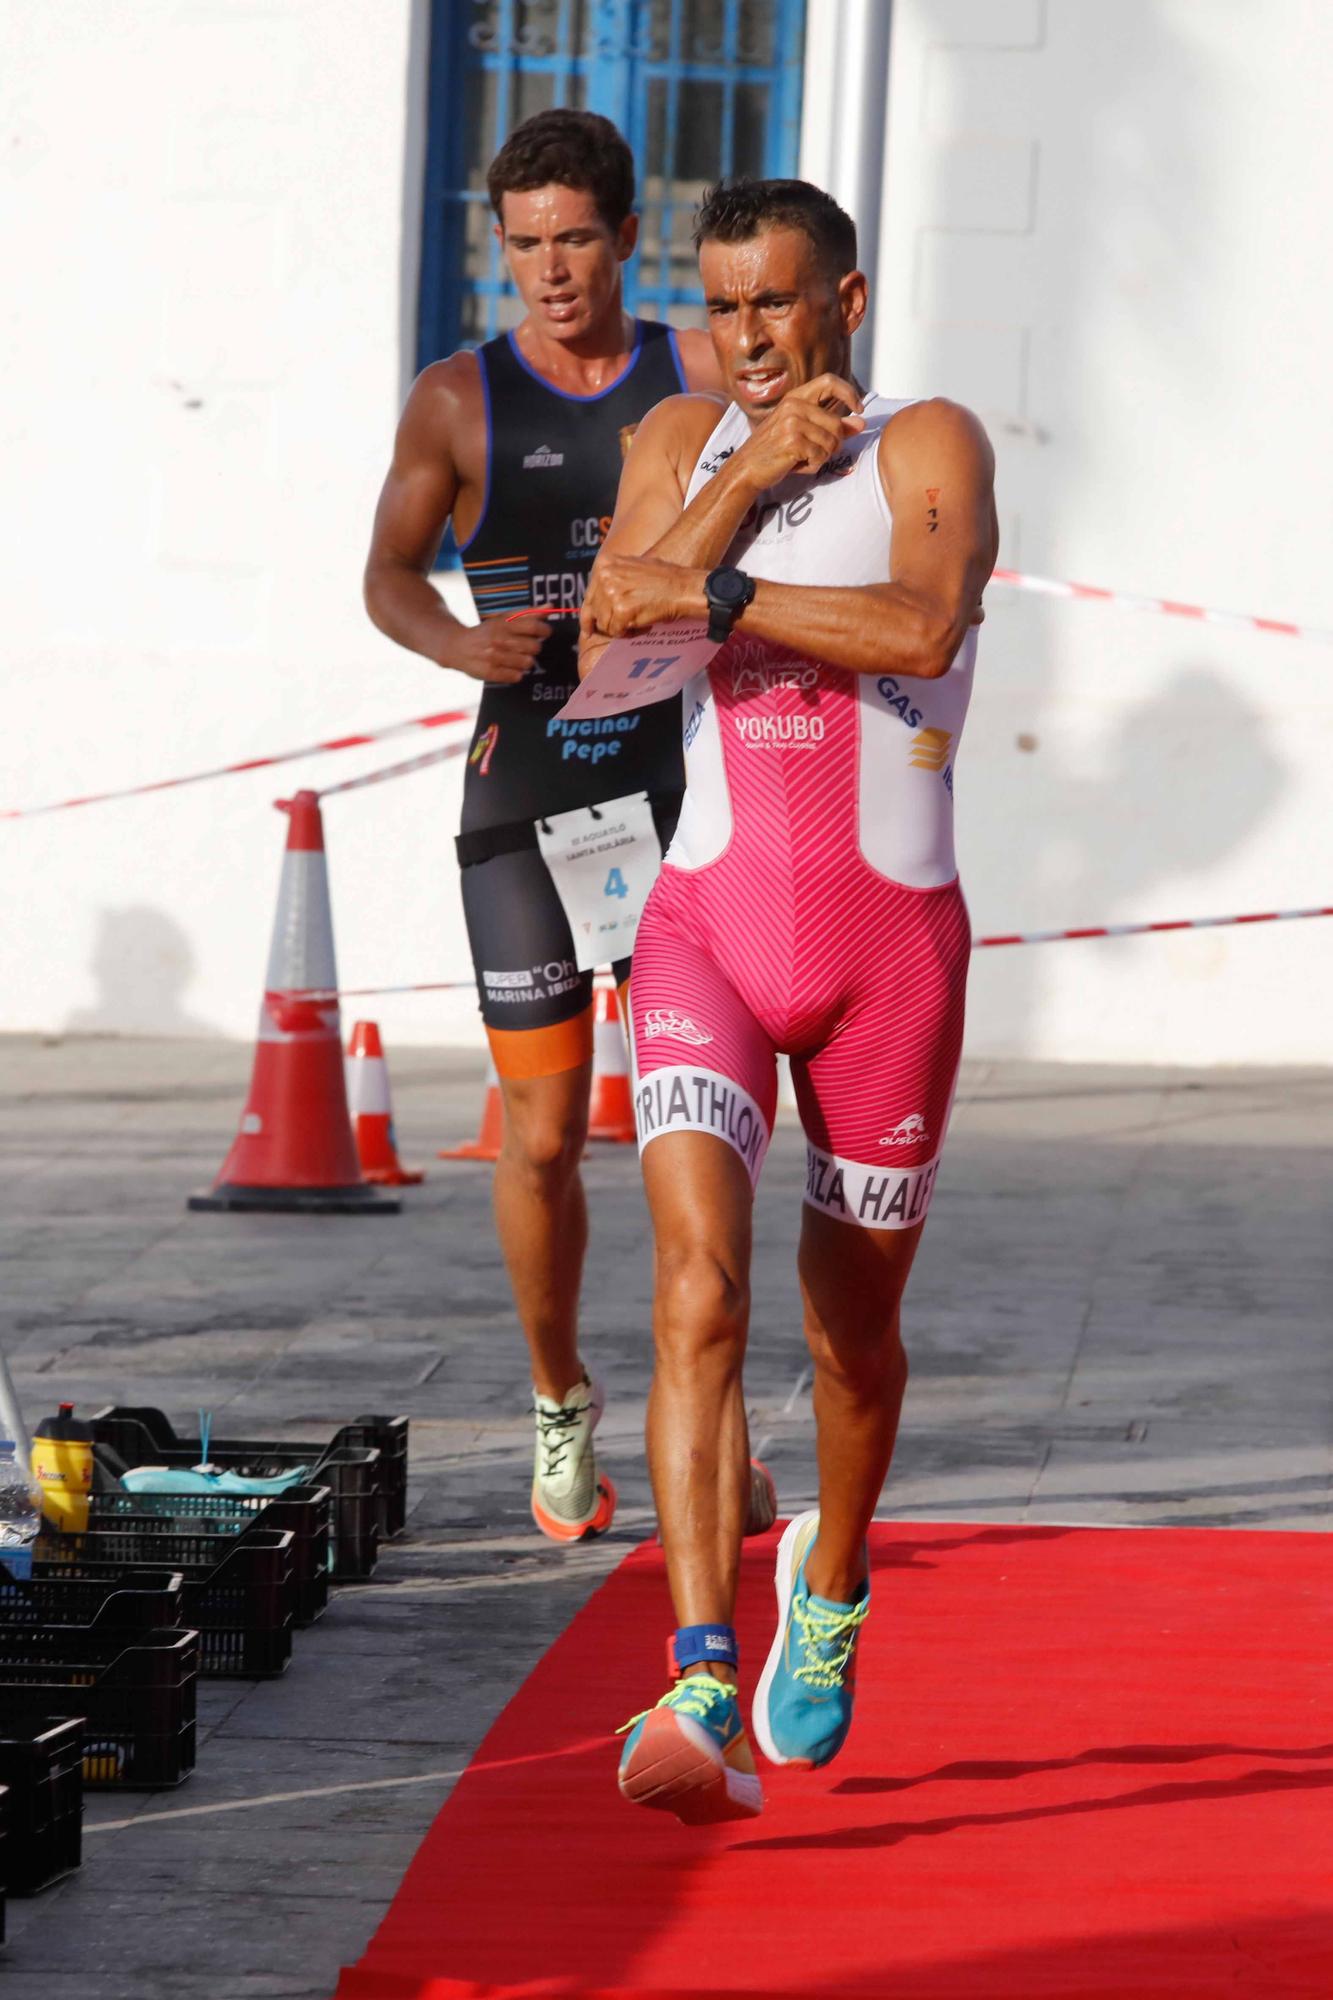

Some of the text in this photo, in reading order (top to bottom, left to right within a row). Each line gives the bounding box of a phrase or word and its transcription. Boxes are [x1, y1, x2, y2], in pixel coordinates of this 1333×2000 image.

[628, 656, 681, 680] 17
[876, 676, 923, 728] GAS
[546, 713, 641, 738] Piscinas
[735, 715, 825, 741] YOKUBO
[561, 740, 622, 765] Pepe
[604, 867, 629, 899] 4
[487, 976, 582, 1003] MARINA IBIZA
[644, 1019, 697, 1040] IBIZA
[636, 1075, 764, 1171] TRIATHLON
[858, 1167, 934, 1222] HALF
